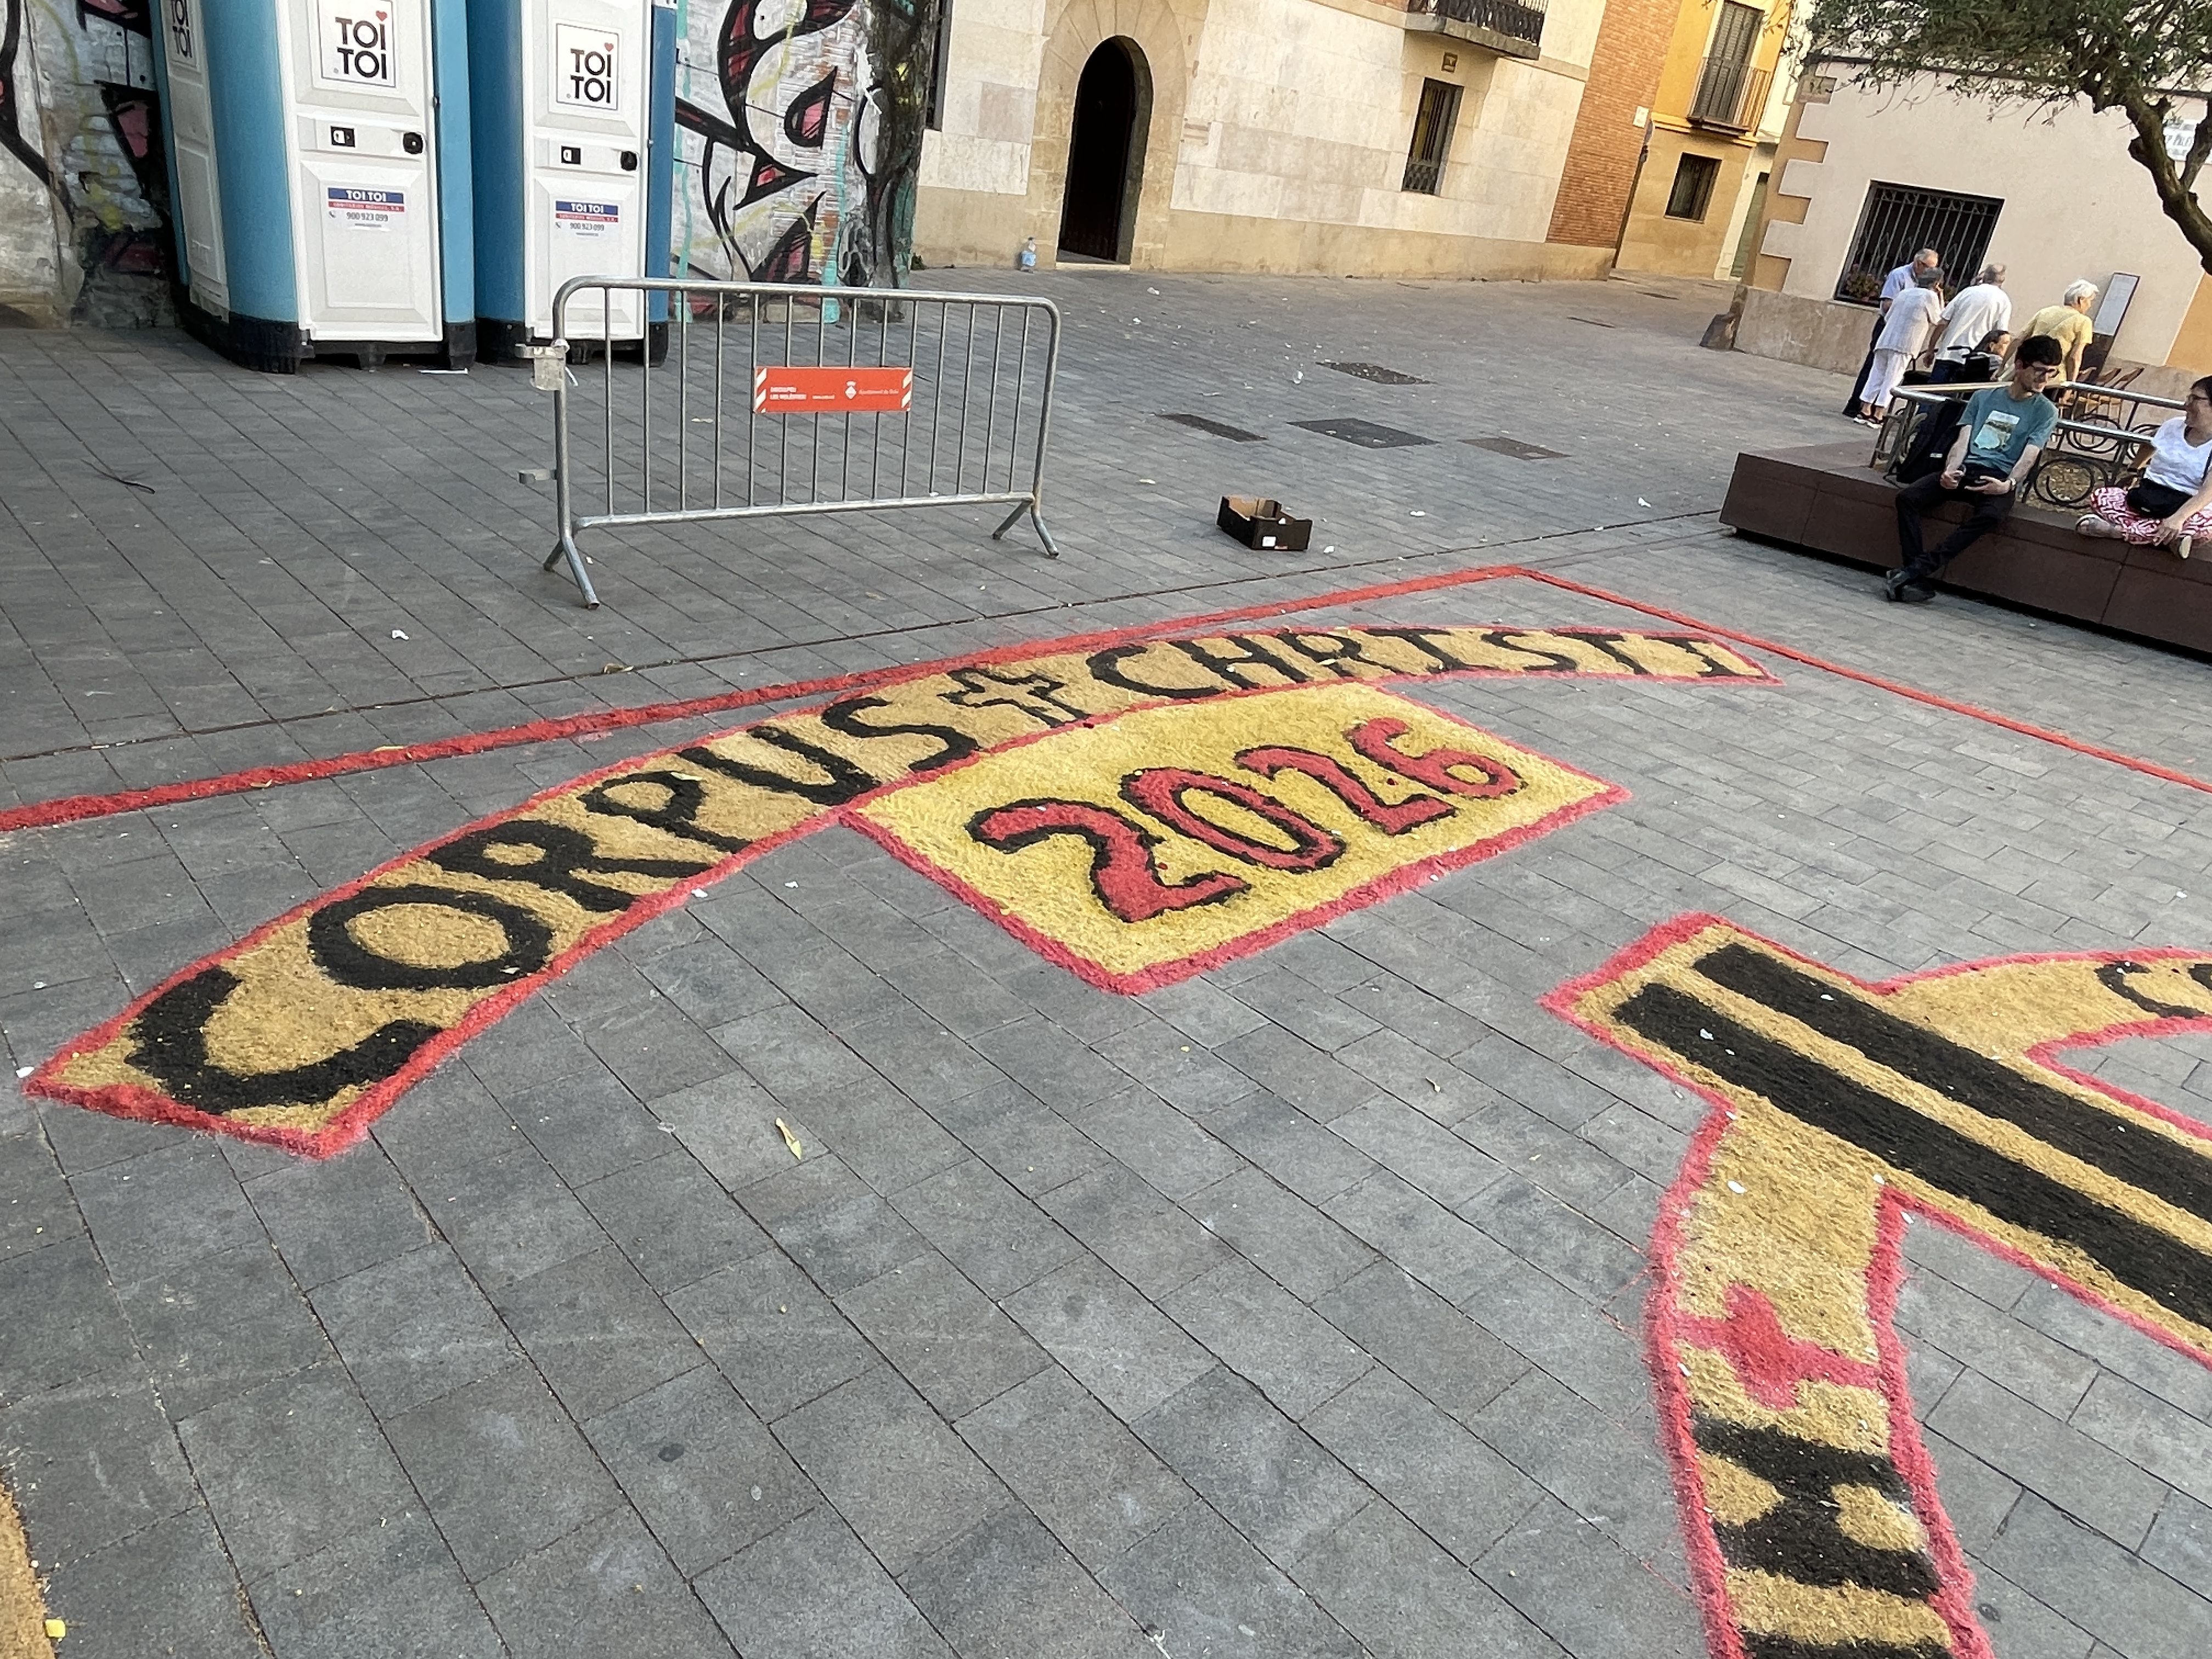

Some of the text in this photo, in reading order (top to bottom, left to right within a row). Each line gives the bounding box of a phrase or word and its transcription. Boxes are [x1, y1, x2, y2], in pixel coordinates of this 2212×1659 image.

[172, 25, 193, 58] TOI
[335, 14, 386, 50] TOI
[336, 47, 387, 80] TOI
[570, 46, 612, 77] TOI
[570, 75, 611, 104] TOI
[346, 190, 387, 202] TOI TOI
[571, 203, 603, 215] TOI TOI
[964, 717, 1528, 923] 2026
[125, 628, 1768, 1114] CORPUS CHRISTI
